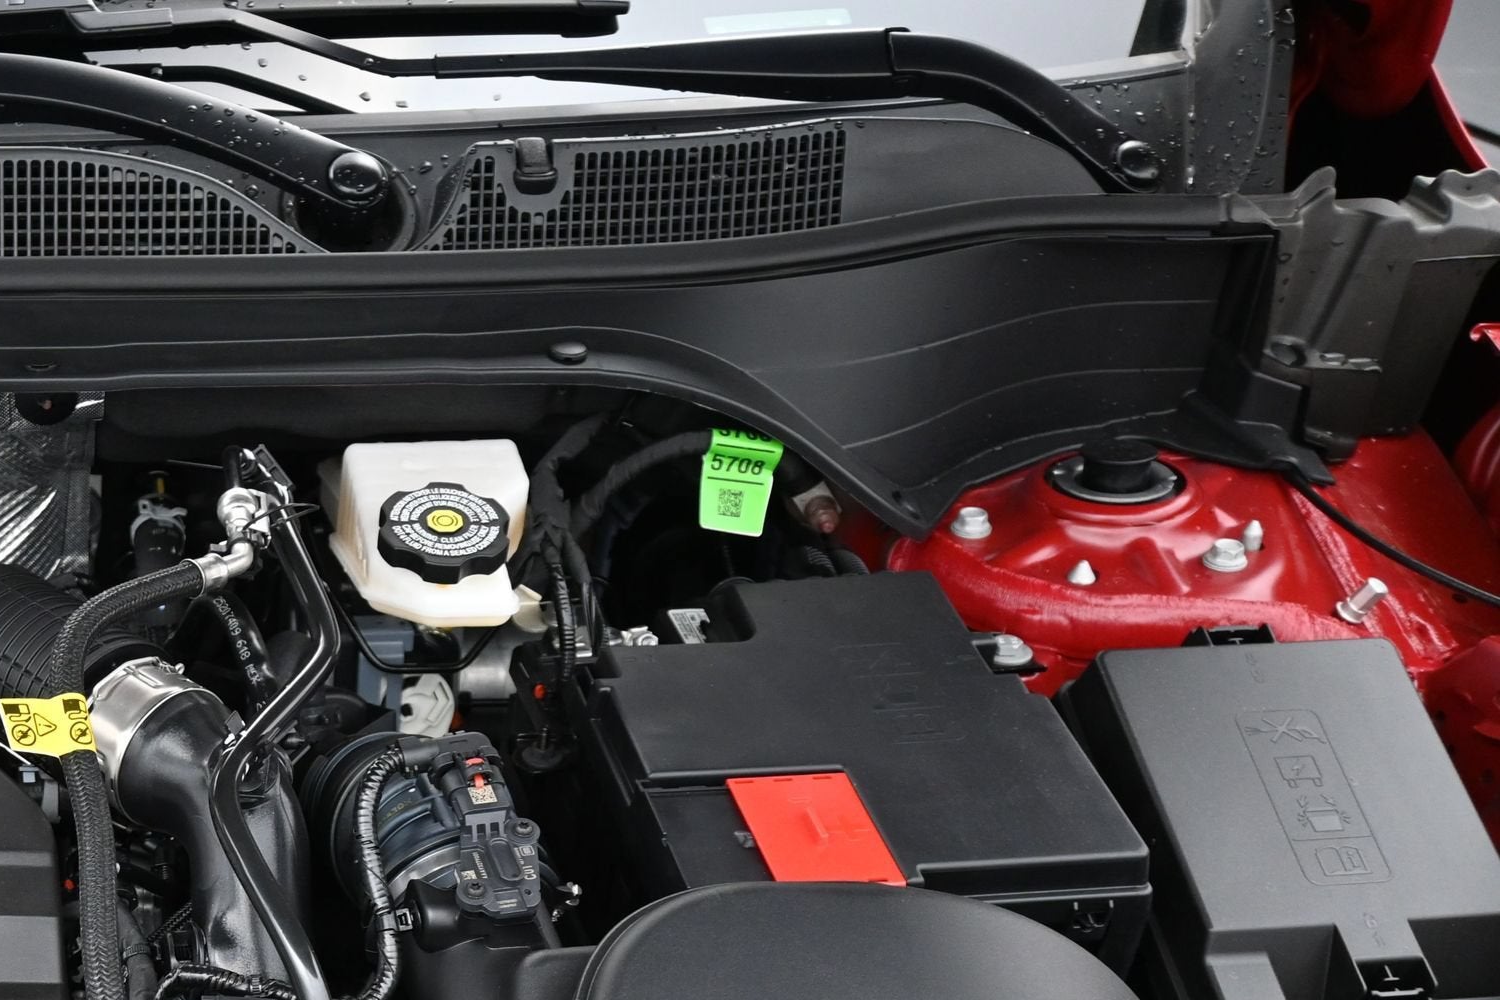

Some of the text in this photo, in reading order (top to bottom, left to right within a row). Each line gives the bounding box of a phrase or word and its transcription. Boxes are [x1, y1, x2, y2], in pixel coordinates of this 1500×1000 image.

[711, 454, 765, 475] 5708
[419, 546, 443, 556] FROM
[236, 638, 252, 662] 618
